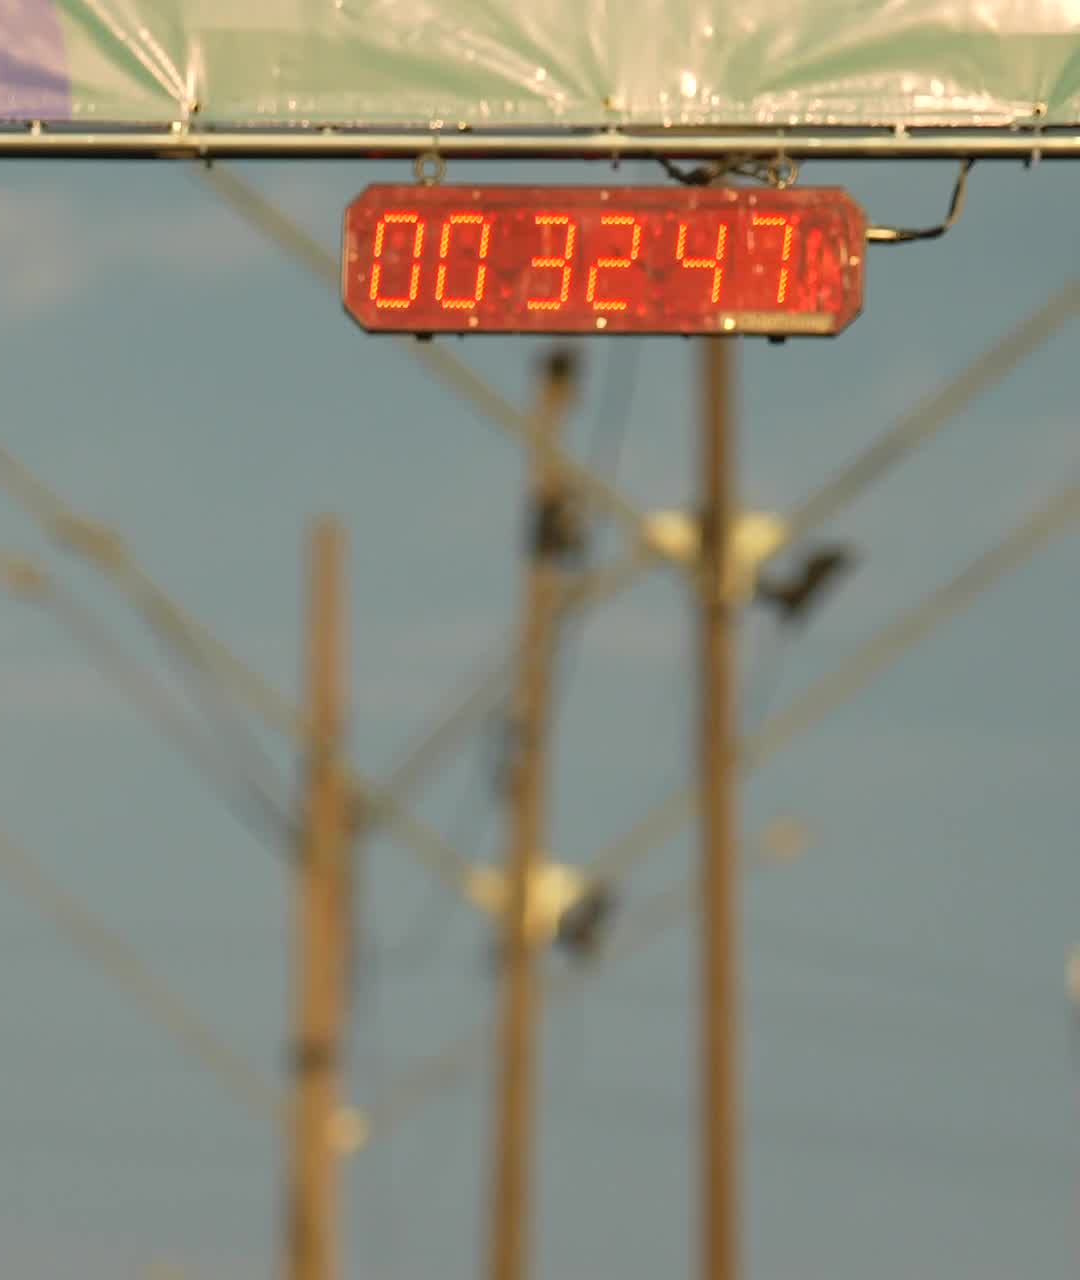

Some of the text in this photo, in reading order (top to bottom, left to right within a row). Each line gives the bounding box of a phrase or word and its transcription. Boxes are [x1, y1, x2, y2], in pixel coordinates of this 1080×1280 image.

[369, 211, 793, 311] 00 32 47
